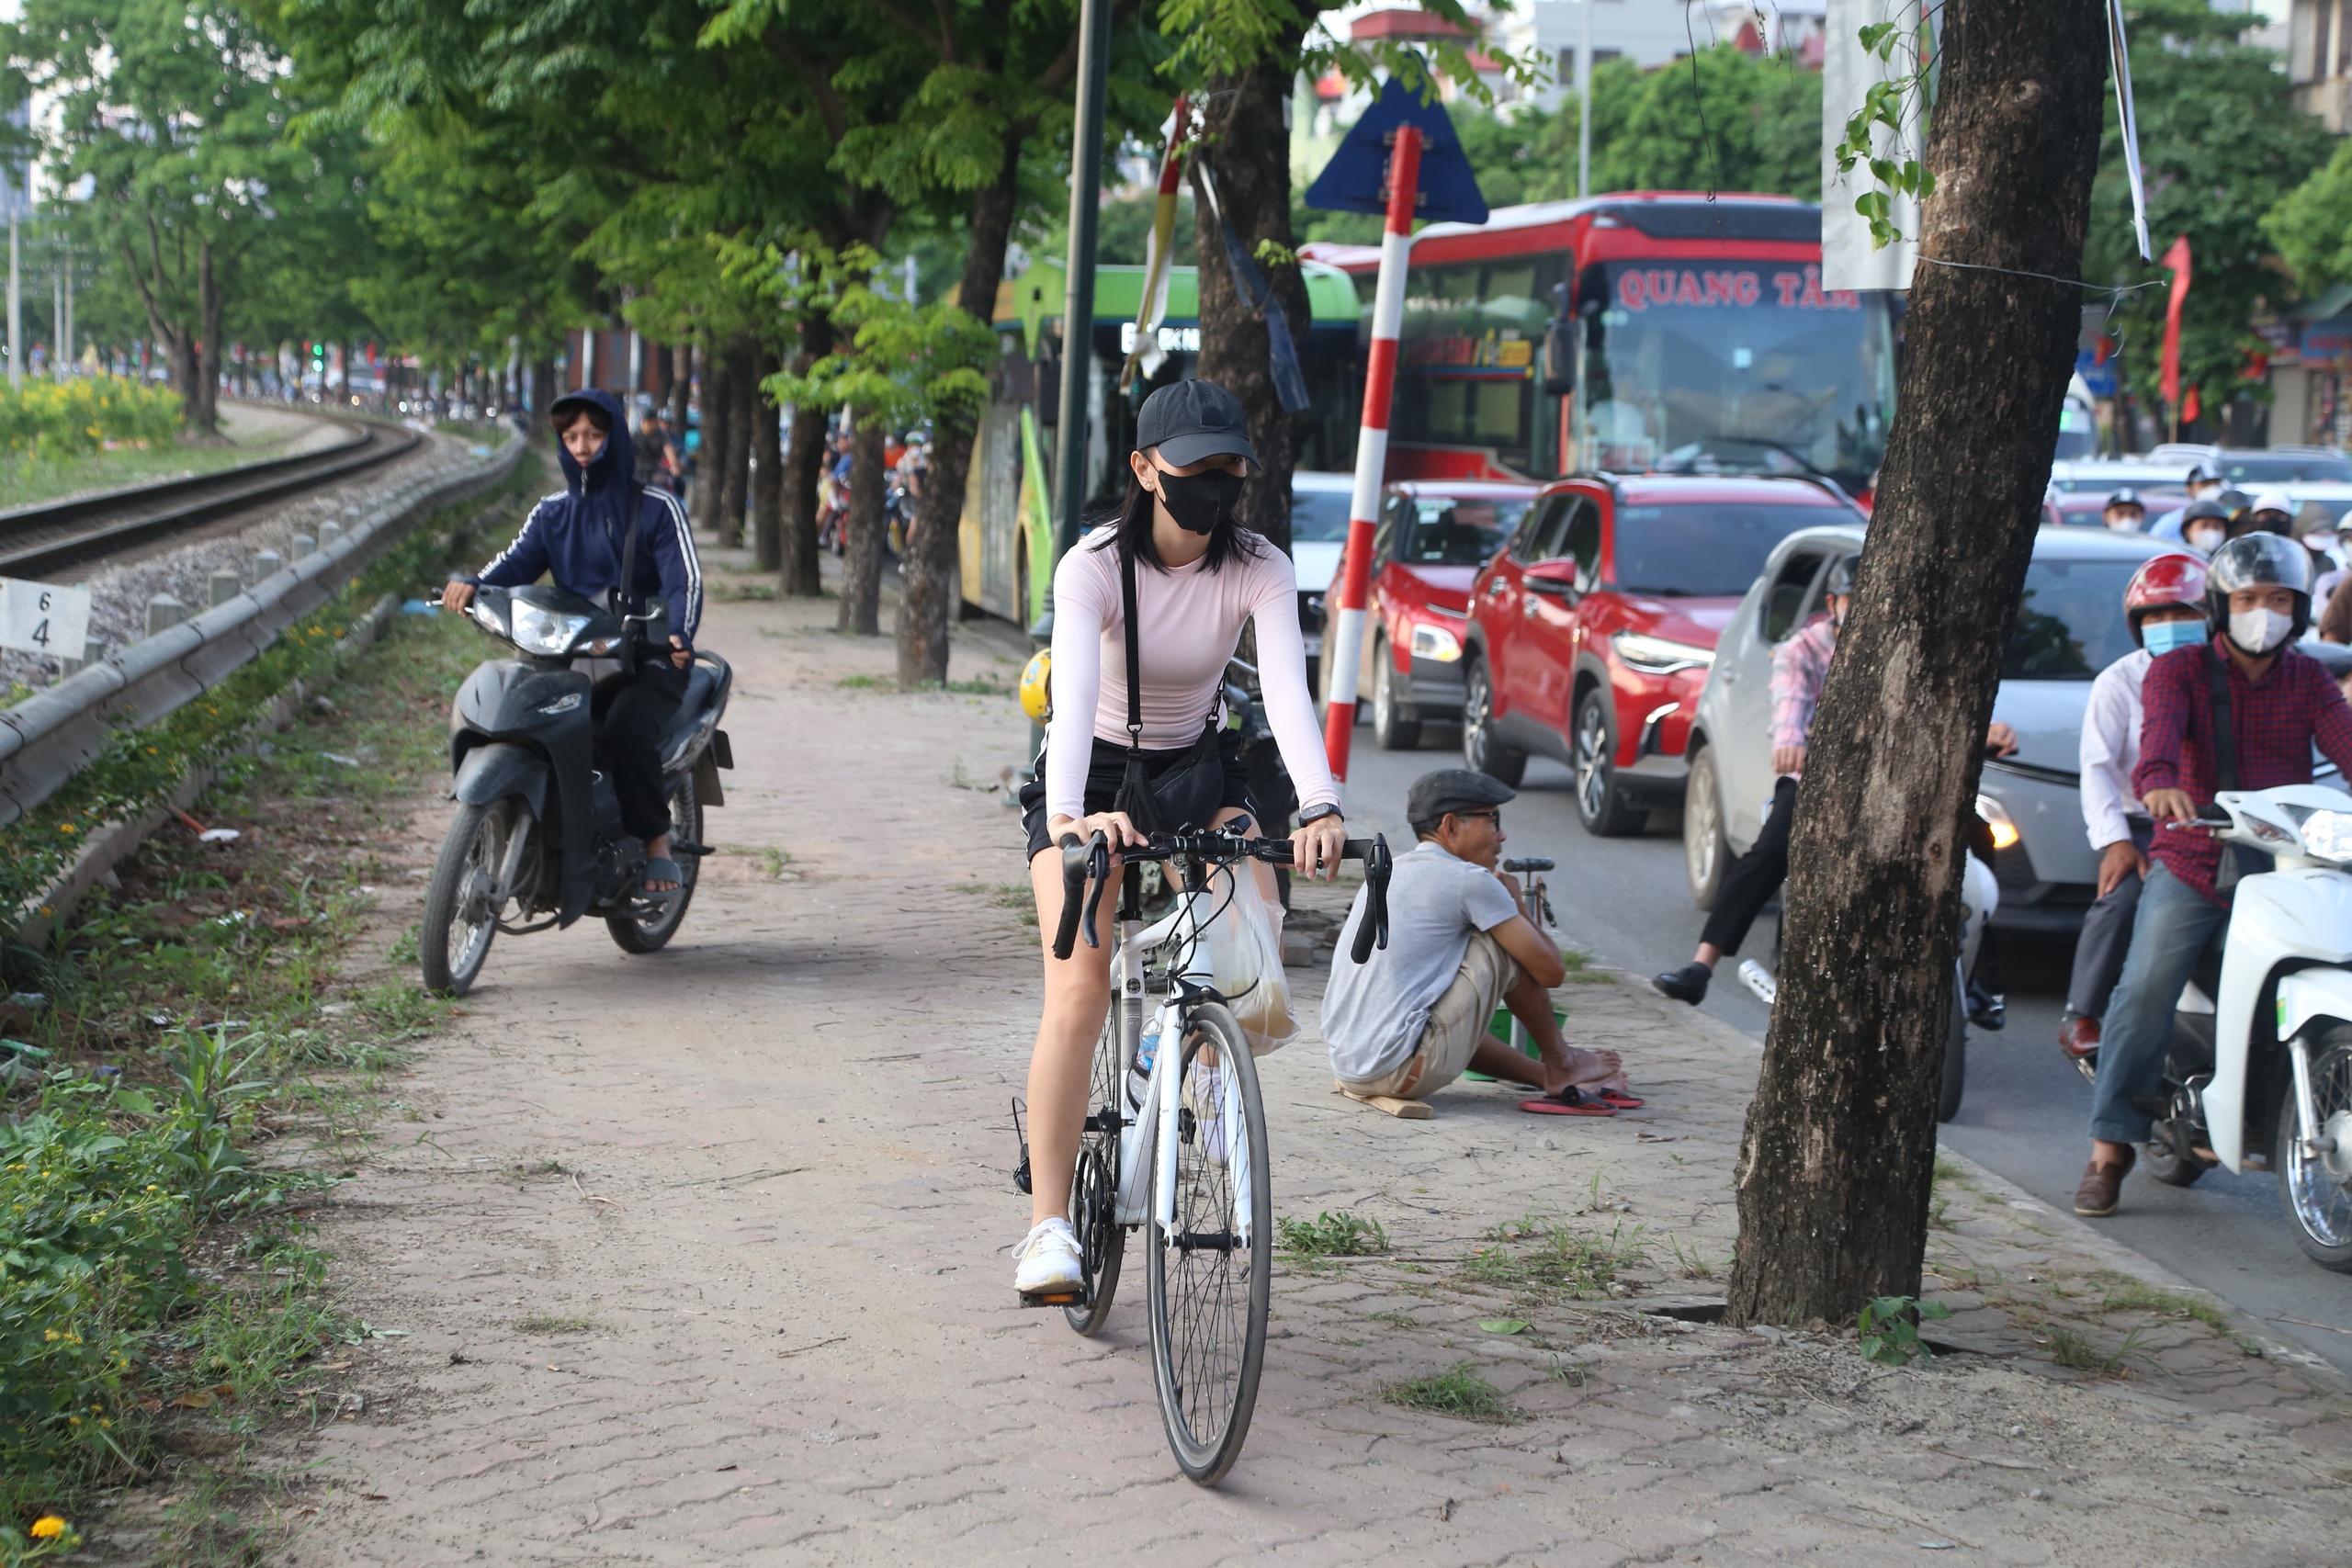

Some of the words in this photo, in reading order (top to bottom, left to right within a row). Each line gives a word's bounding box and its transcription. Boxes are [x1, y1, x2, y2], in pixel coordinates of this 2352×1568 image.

[1618, 270, 1760, 311] QUANG
[40, 591, 51, 612] 6
[31, 618, 51, 648] 4
